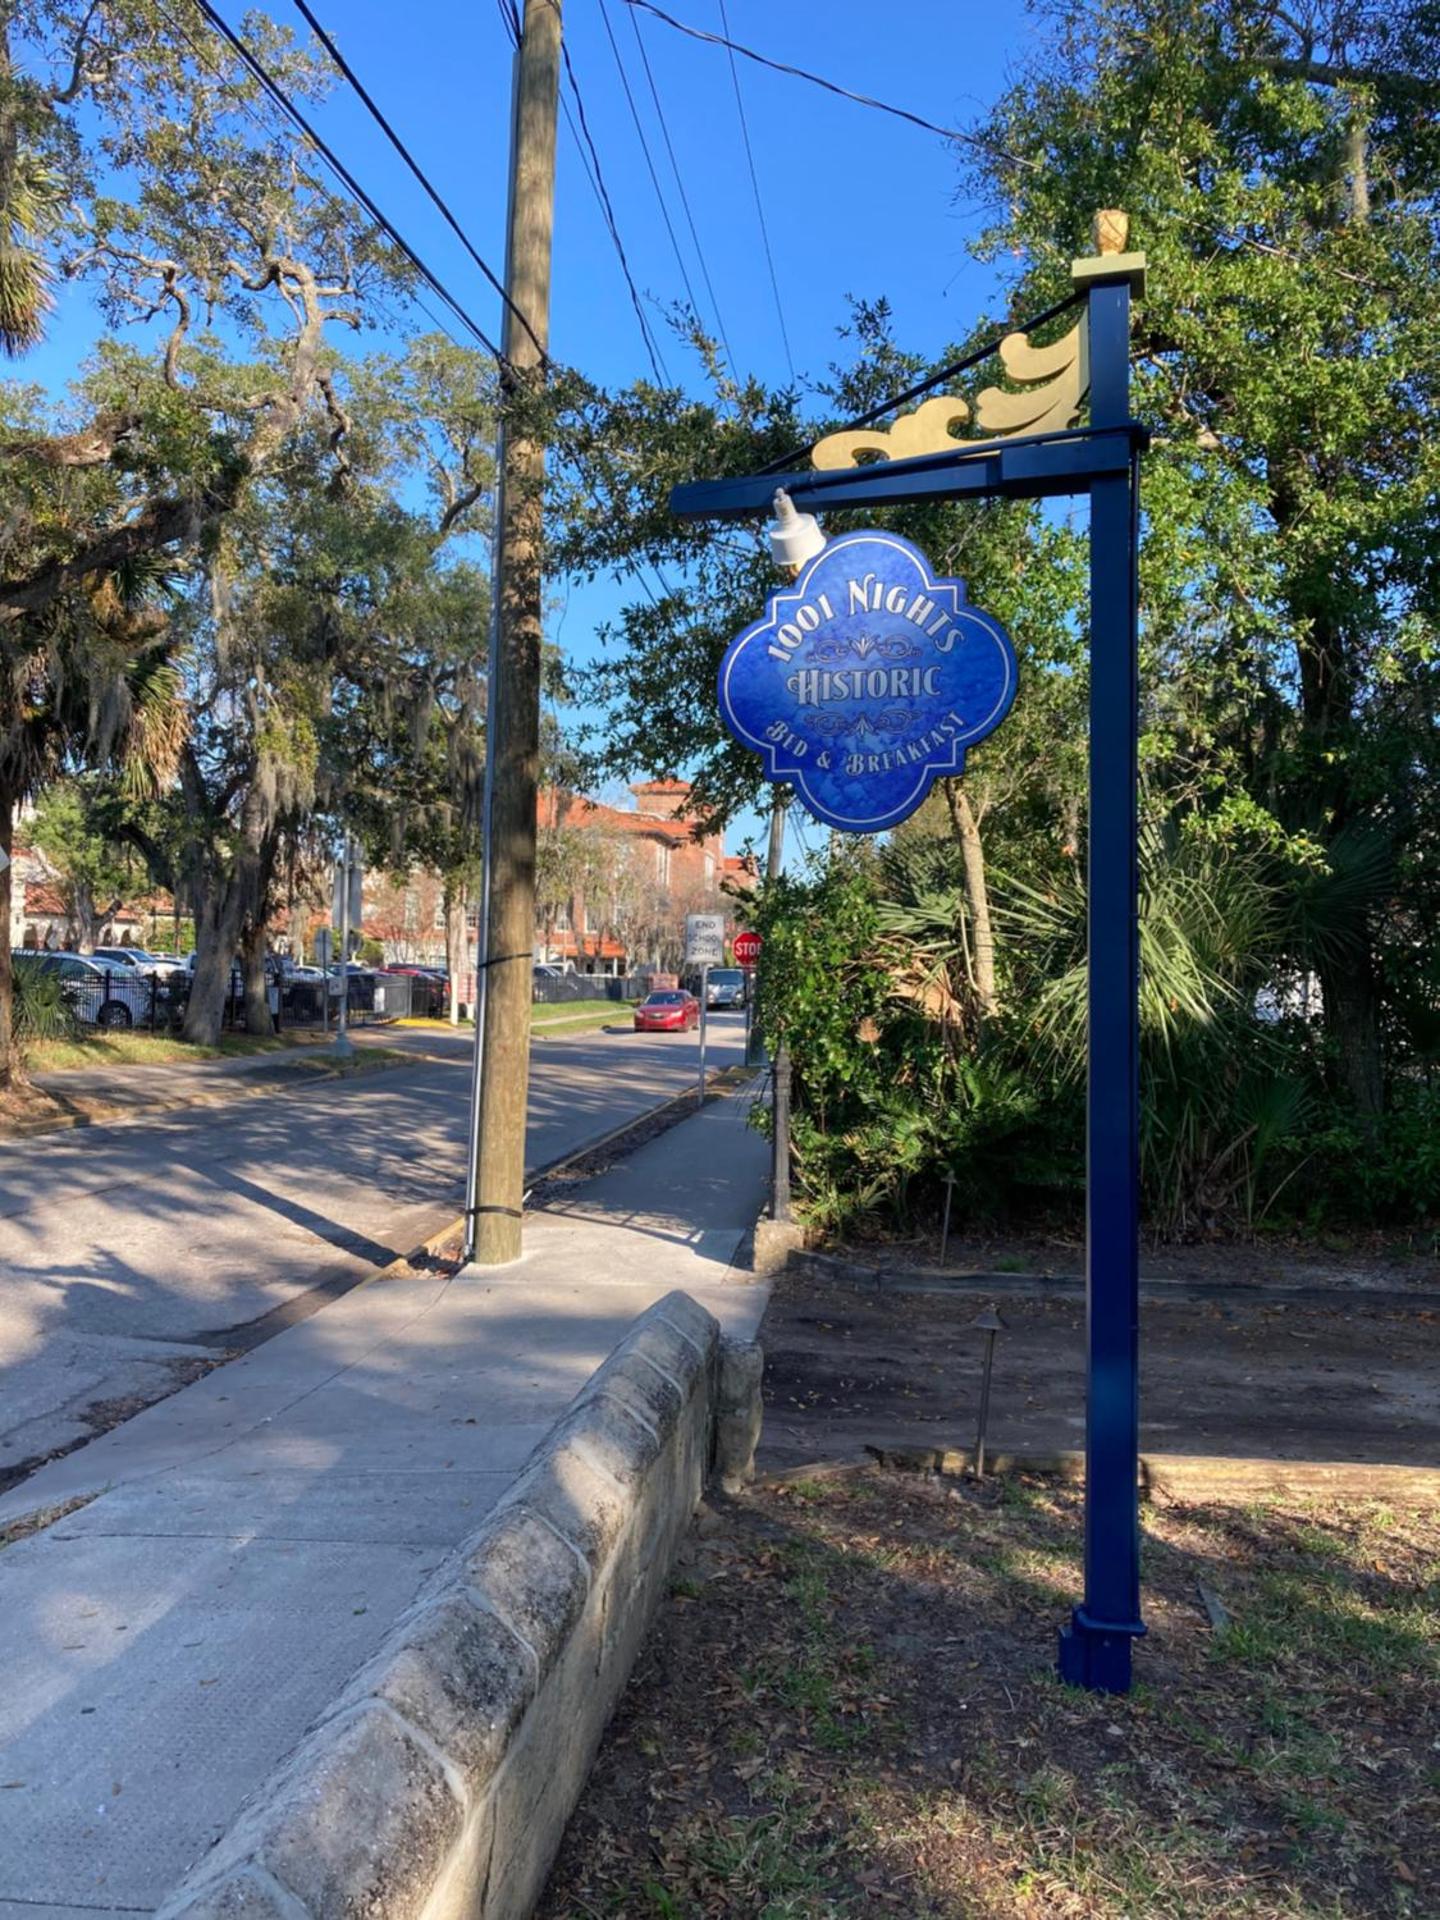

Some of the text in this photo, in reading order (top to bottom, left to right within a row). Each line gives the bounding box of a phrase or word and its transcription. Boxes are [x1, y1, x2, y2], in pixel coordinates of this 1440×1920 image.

[768, 573, 964, 663] 1001 NIGHTS
[787, 666, 941, 708] HISTORIC
[766, 711, 964, 776] BED & BREAKFAST
[695, 920, 716, 929] END
[691, 947, 718, 957] ZONE
